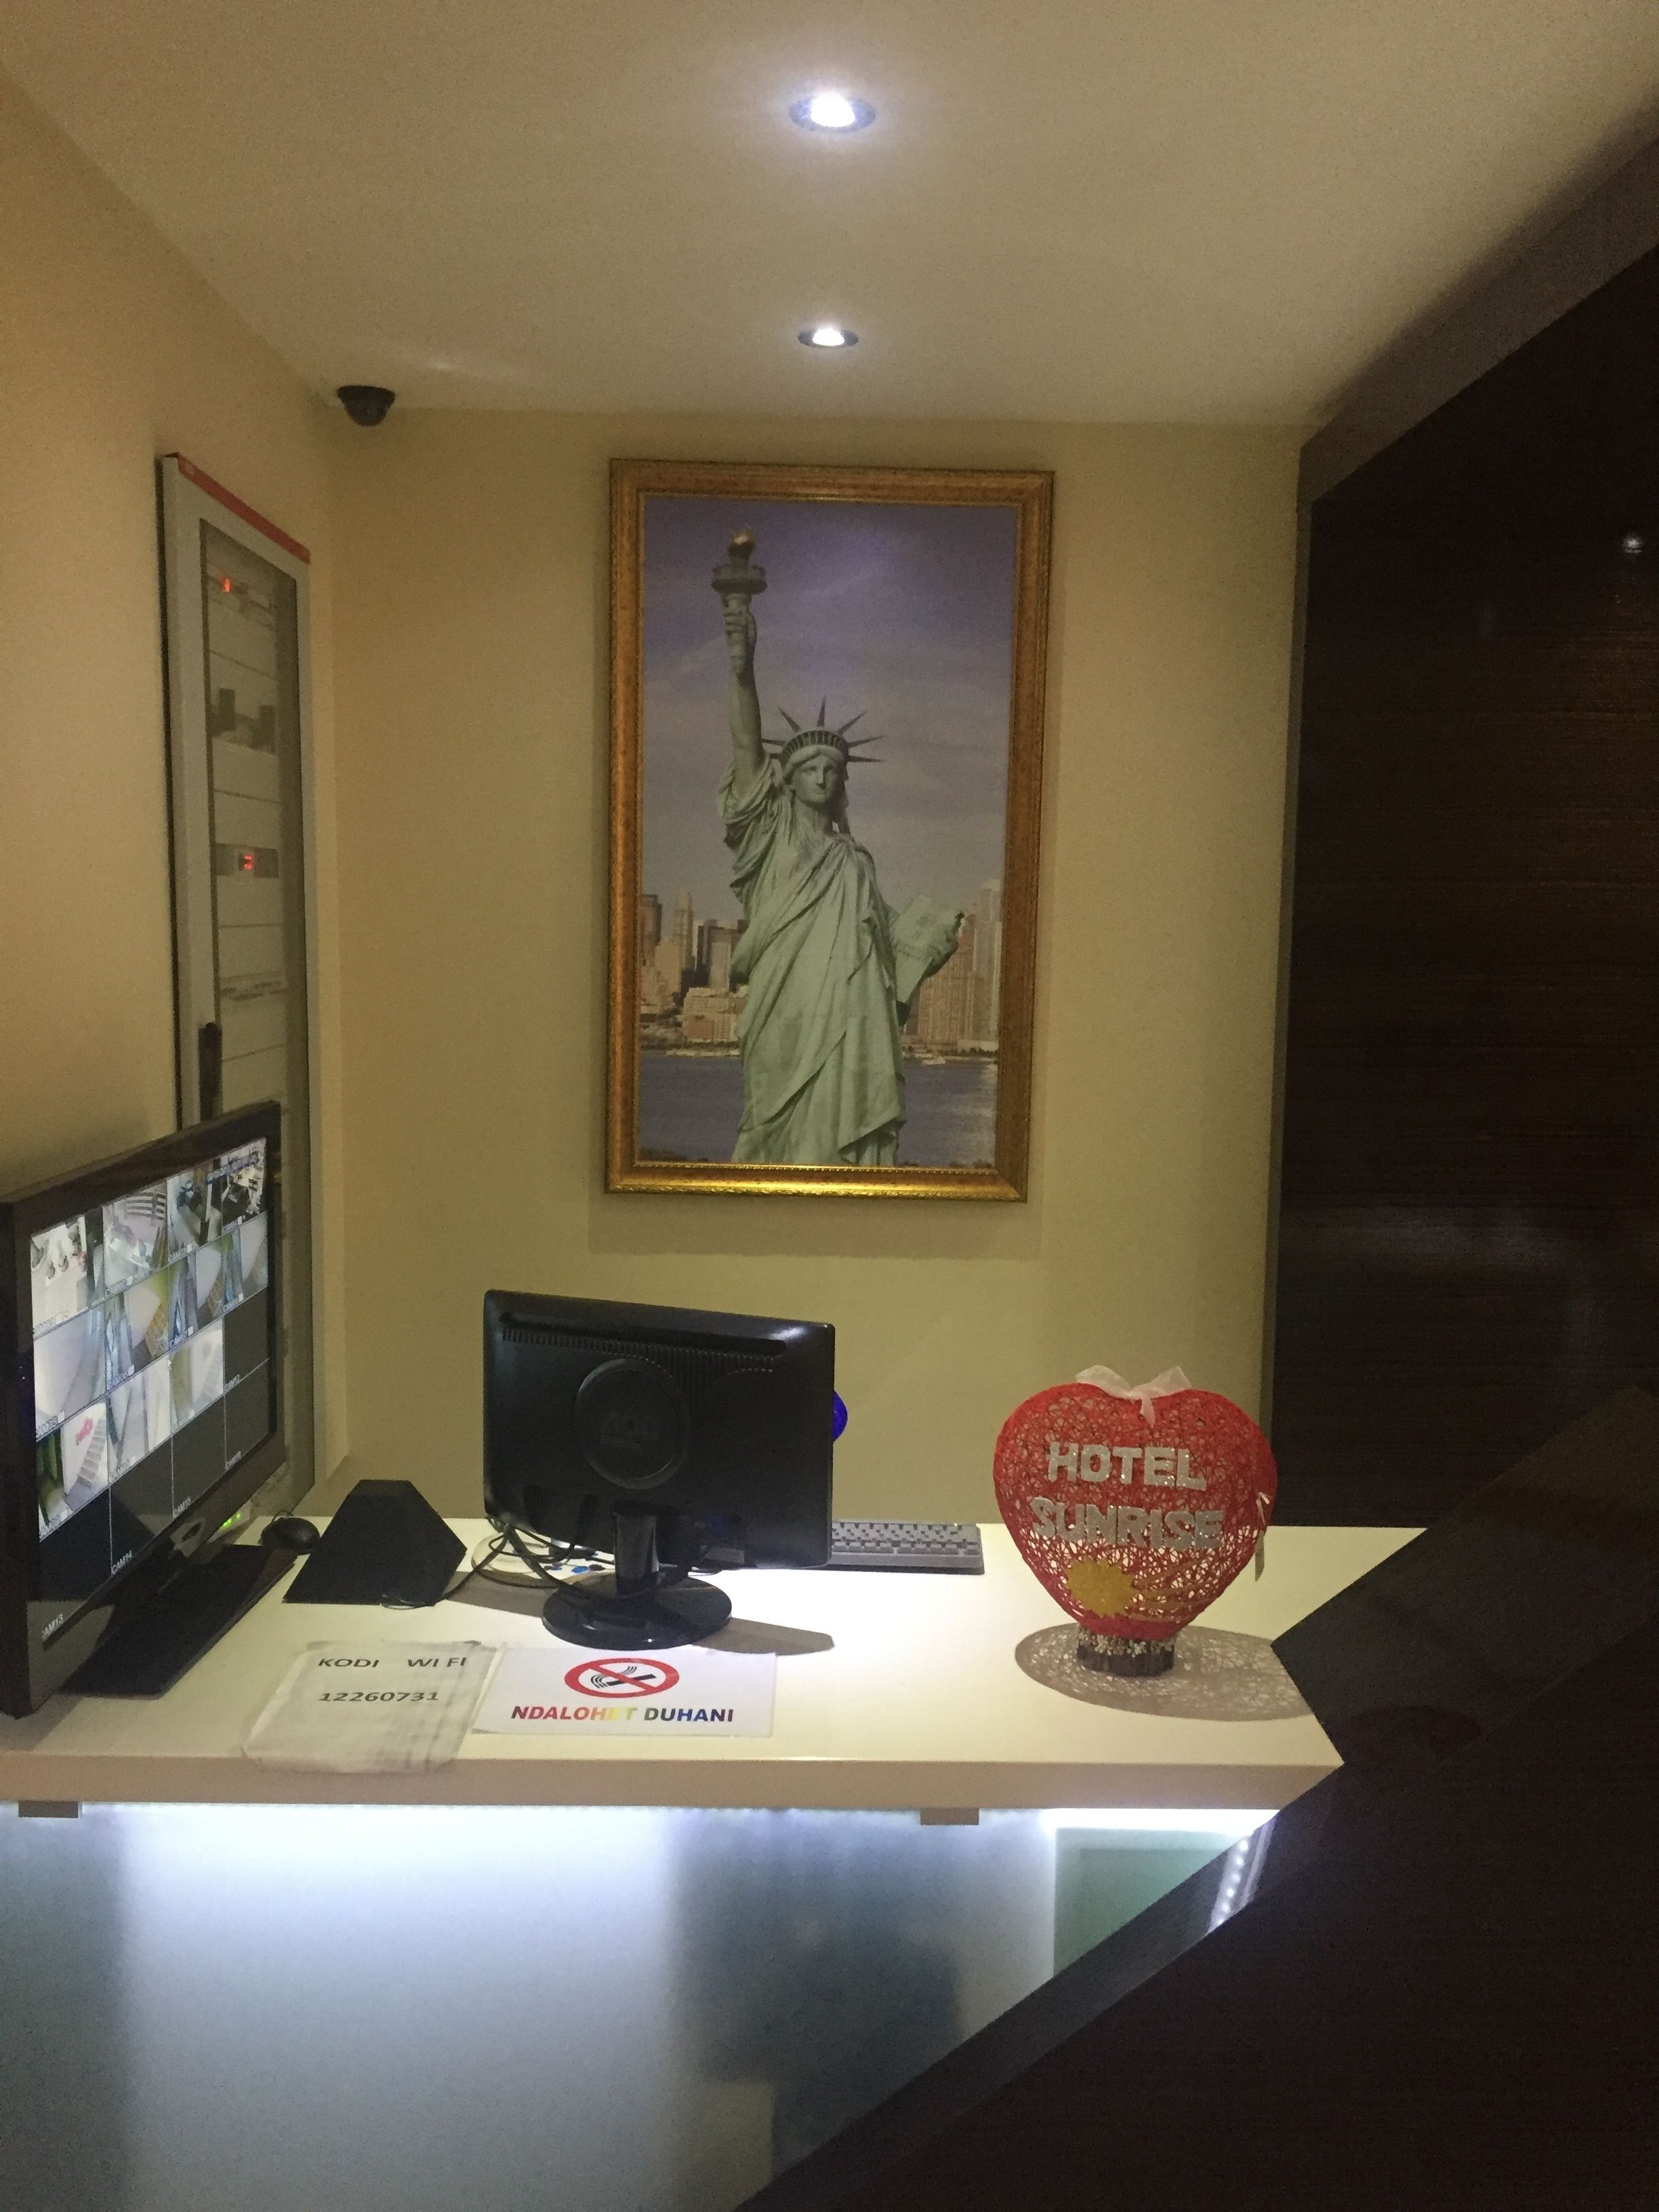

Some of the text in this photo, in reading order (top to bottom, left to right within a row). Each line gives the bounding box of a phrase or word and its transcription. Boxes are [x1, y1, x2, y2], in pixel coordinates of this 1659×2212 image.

[1046, 1441, 1207, 1491] HOTEL
[1029, 1495, 1225, 1551] SUNRISE
[318, 1658, 380, 1668] KODI
[407, 1658, 439, 1668] WI
[319, 1692, 438, 1702] 12260731
[510, 1706, 734, 1723] NDALOHET DUHANI
